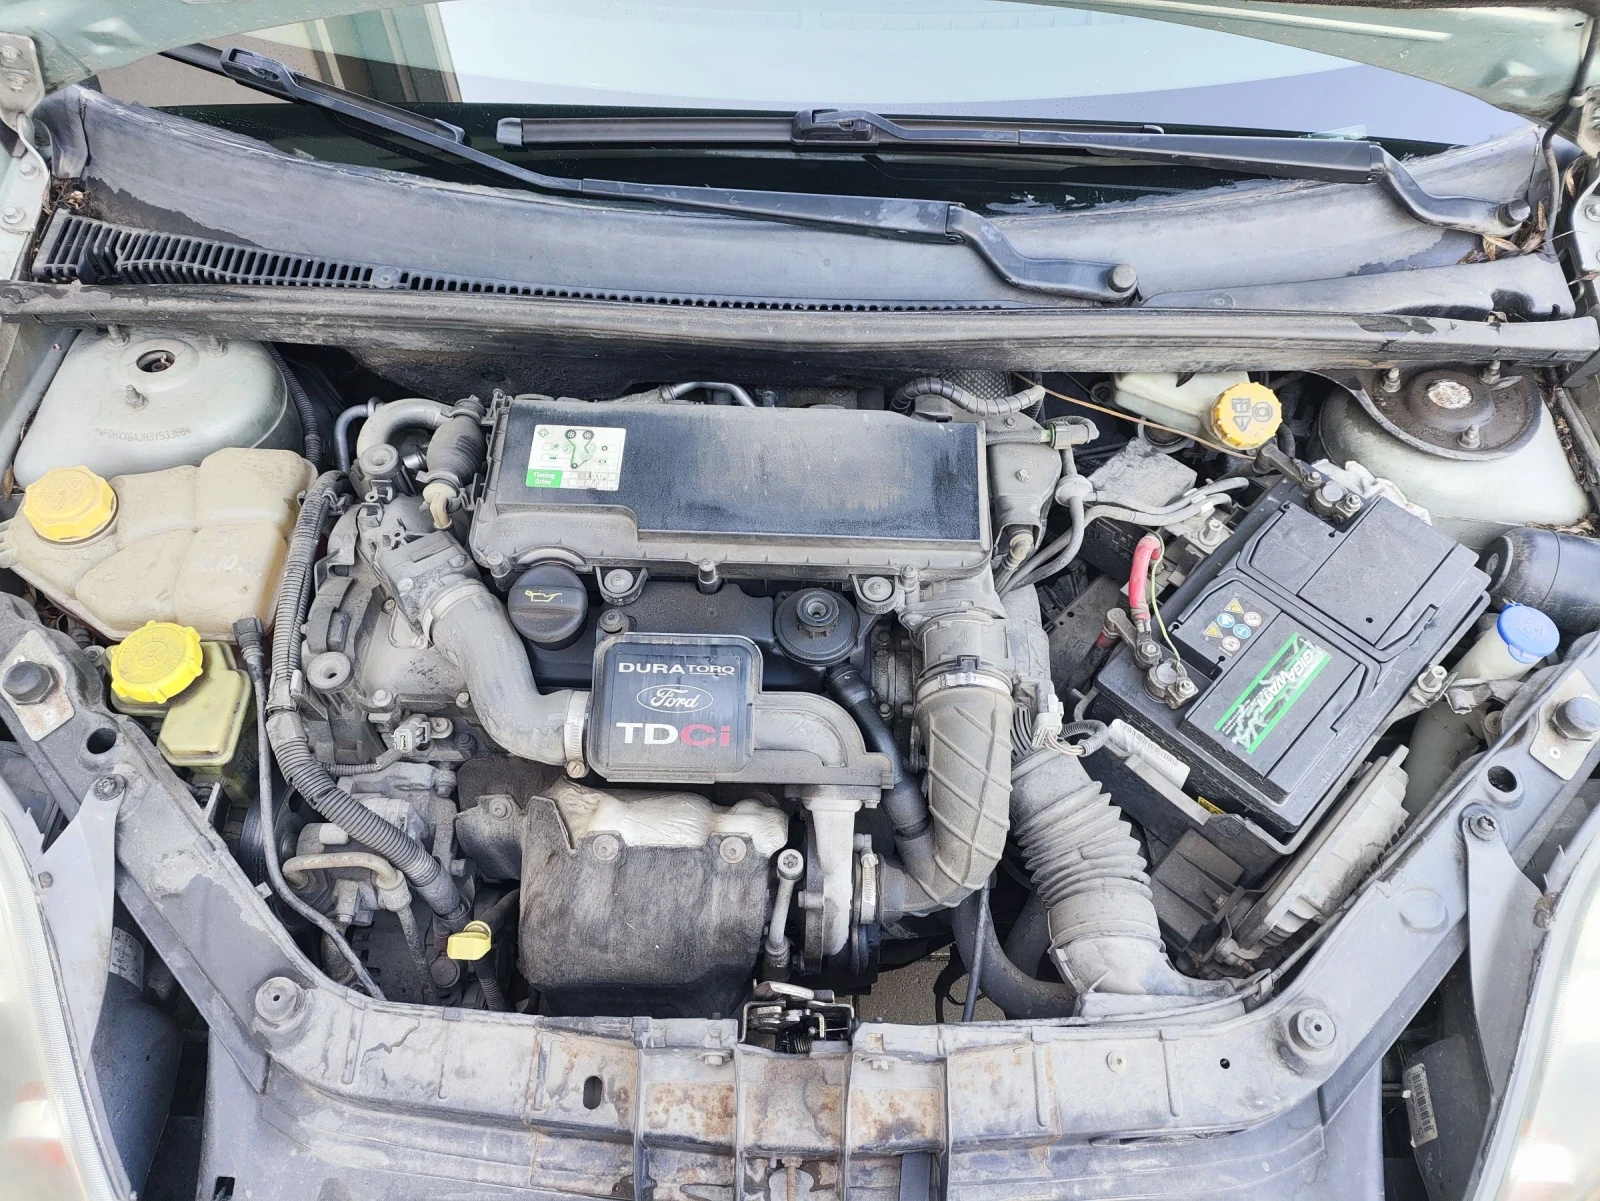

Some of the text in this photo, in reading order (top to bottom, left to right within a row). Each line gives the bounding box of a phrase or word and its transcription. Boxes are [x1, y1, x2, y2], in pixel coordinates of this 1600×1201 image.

[618, 662, 735, 676] DURATORQ
[1257, 648, 1314, 713] GIGAWATT
[650, 687, 700, 708] Ford
[616, 722, 731, 747] TDCi
